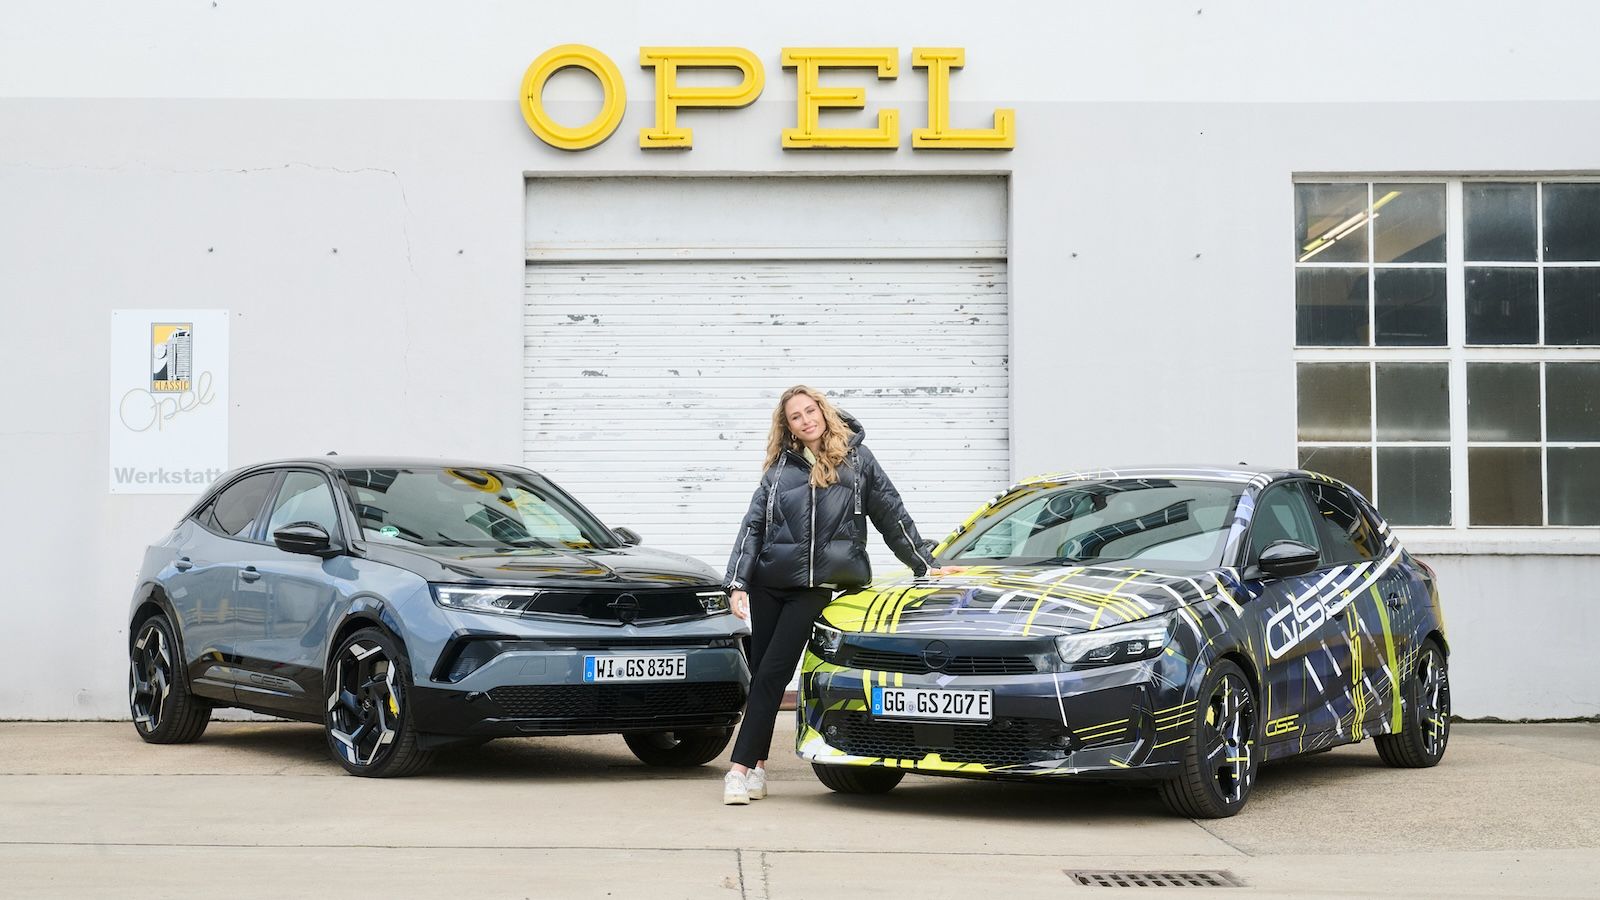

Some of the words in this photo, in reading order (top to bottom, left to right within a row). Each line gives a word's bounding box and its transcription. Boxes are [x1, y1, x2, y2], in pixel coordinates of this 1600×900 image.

[520, 44, 1016, 151] OPEL
[153, 380, 189, 391] CLASSIC
[119, 371, 216, 432] Opel
[596, 659, 614, 678] WI
[626, 659, 645, 677] GS
[884, 691, 905, 712] GG
[917, 692, 939, 713] GS
